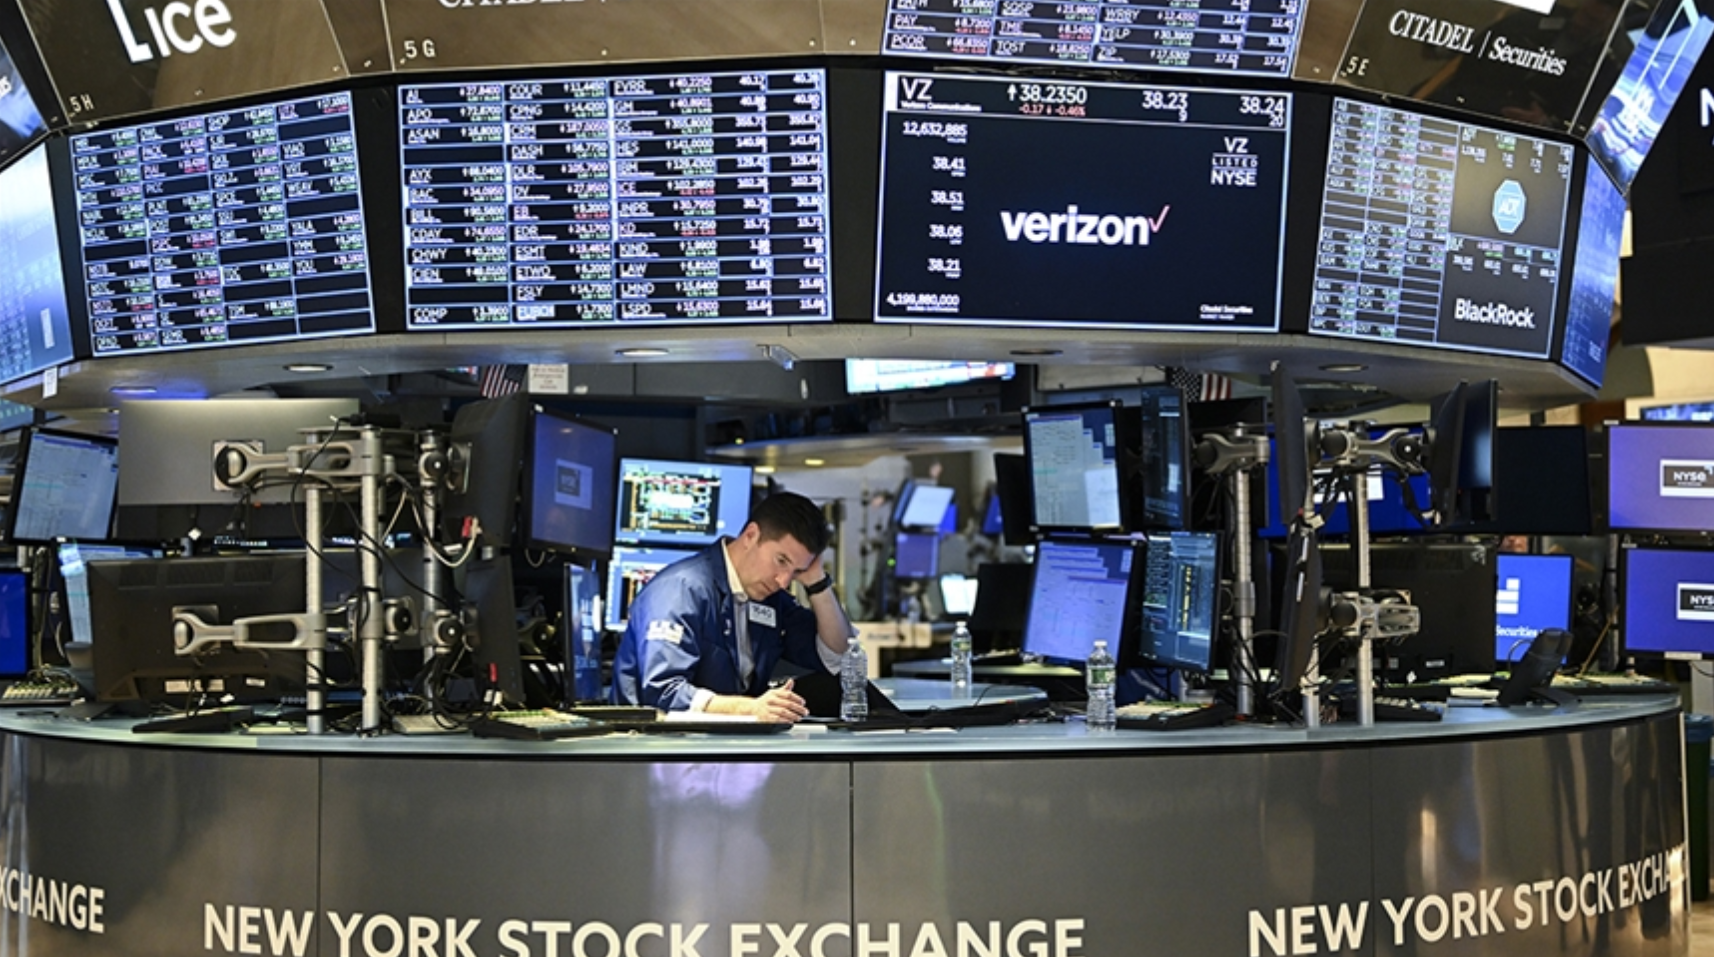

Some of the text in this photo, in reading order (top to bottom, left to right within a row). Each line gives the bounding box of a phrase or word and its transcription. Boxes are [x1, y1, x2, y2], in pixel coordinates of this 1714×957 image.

[895, 14, 918, 27] PAY
[1103, 29, 1131, 39] YELP
[996, 41, 1026, 52] TOST
[1389, 10, 1567, 76] CITADEL Securities
[509, 84, 542, 96] COUR
[901, 78, 1285, 115] VZ 38.2350 38.23 38.24
[407, 108, 432, 119] APO
[510, 105, 543, 117] CPNG
[1018, 104, 1044, 115] -0.17
[1178, 109, 1188, 122] 9
[1268, 113, 1284, 127] 20
[408, 129, 440, 140] ASAN
[511, 145, 543, 157] DASH
[1224, 136, 1249, 154] VZ
[932, 156, 966, 170] 38.41
[1211, 156, 1258, 168] LISTED
[409, 169, 432, 180] AYX
[513, 164, 536, 176] DLR
[1210, 170, 1257, 187] NYSE
[928, 223, 963, 238] 38.06
[1000, 204, 1150, 246] verizon
[411, 229, 442, 239] CDAY
[412, 248, 448, 259] CHWY
[620, 263, 647, 275] LAW
[927, 258, 961, 272] 38.21
[620, 282, 655, 295] LMND
[414, 308, 448, 319] COMP
[1248, 900, 1369, 957] NEW
[1382, 889, 1505, 946] YORK
[1513, 868, 1614, 930] STOCK
[204, 903, 1084, 957] NEW YORK STOCK EXCHANGE
